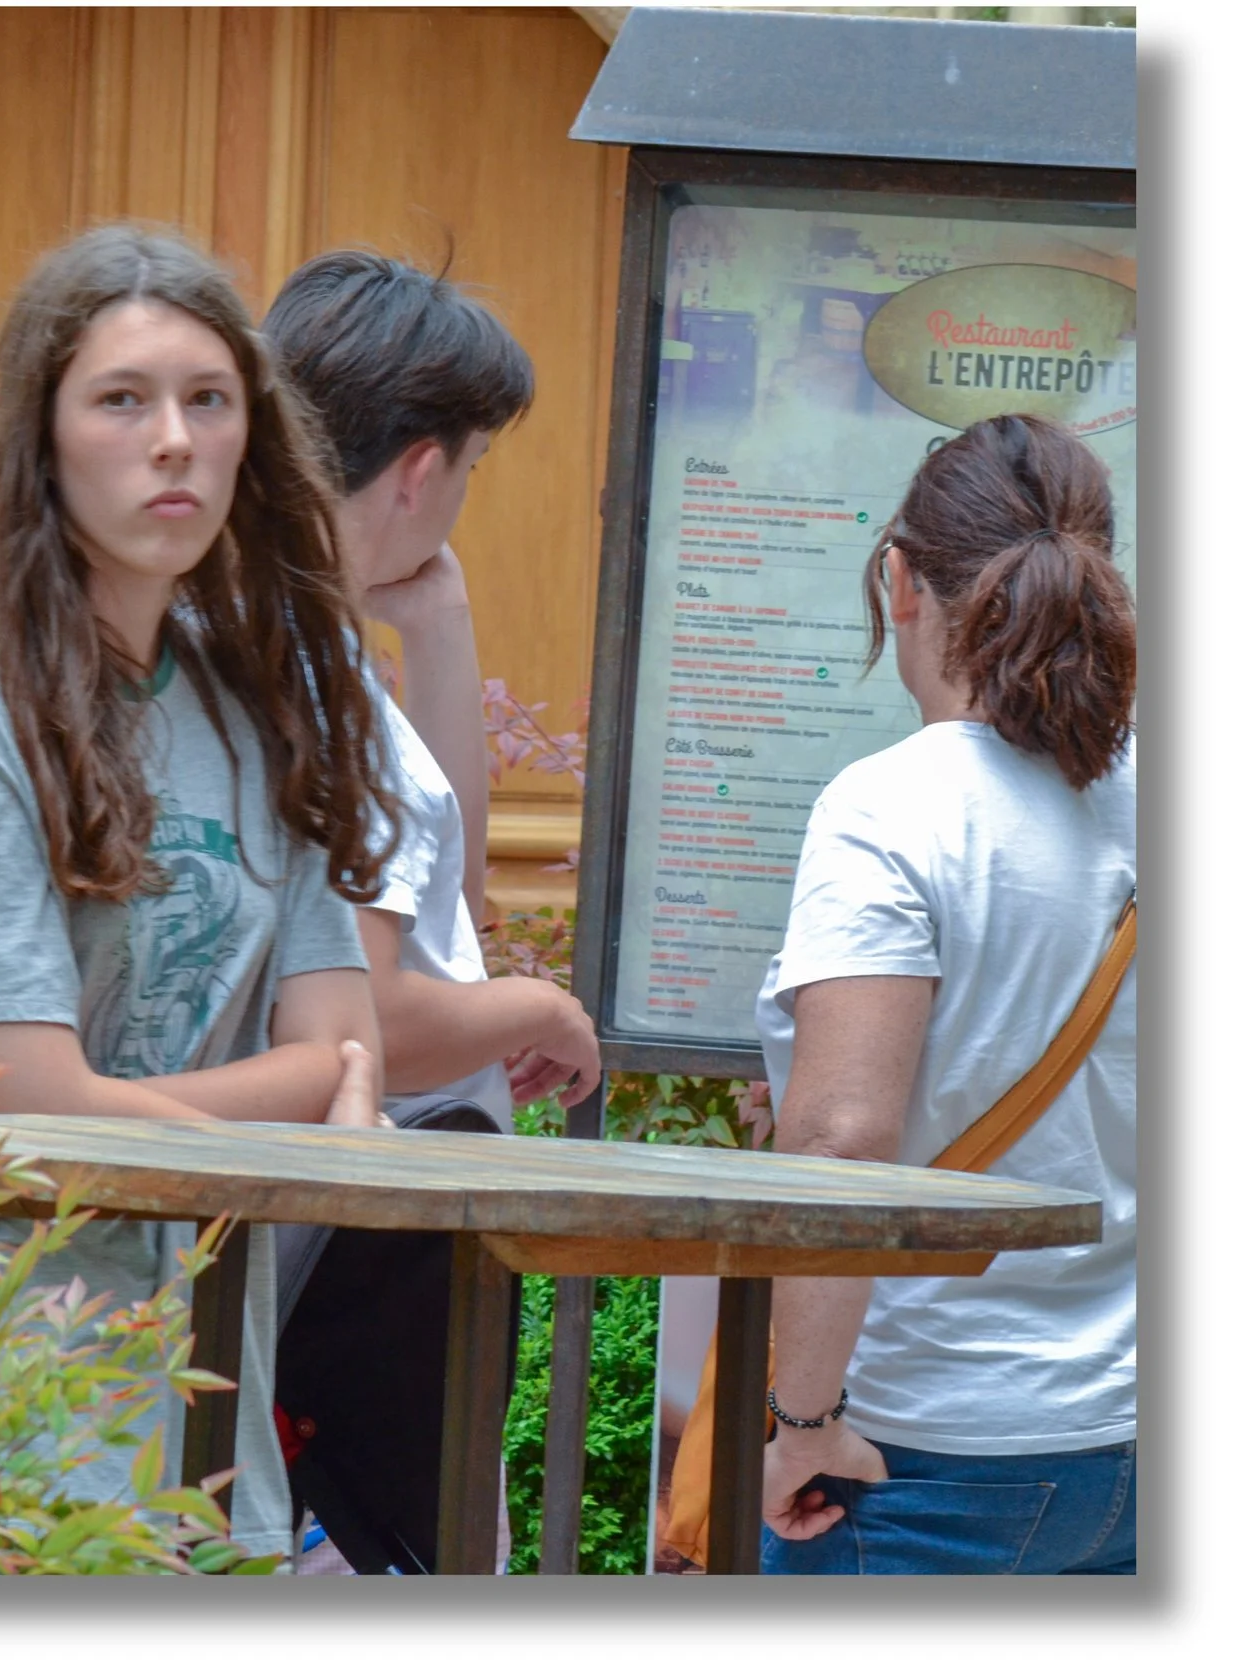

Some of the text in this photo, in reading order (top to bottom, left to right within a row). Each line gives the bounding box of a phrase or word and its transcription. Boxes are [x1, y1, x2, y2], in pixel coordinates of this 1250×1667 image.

[926, 309, 1078, 351] Restaurant
[685, 457, 730, 475] Entrées
[676, 581, 711, 598] Plats
[665, 737, 755, 758] Côté Brasserie
[654, 886, 708, 905] Desserts
